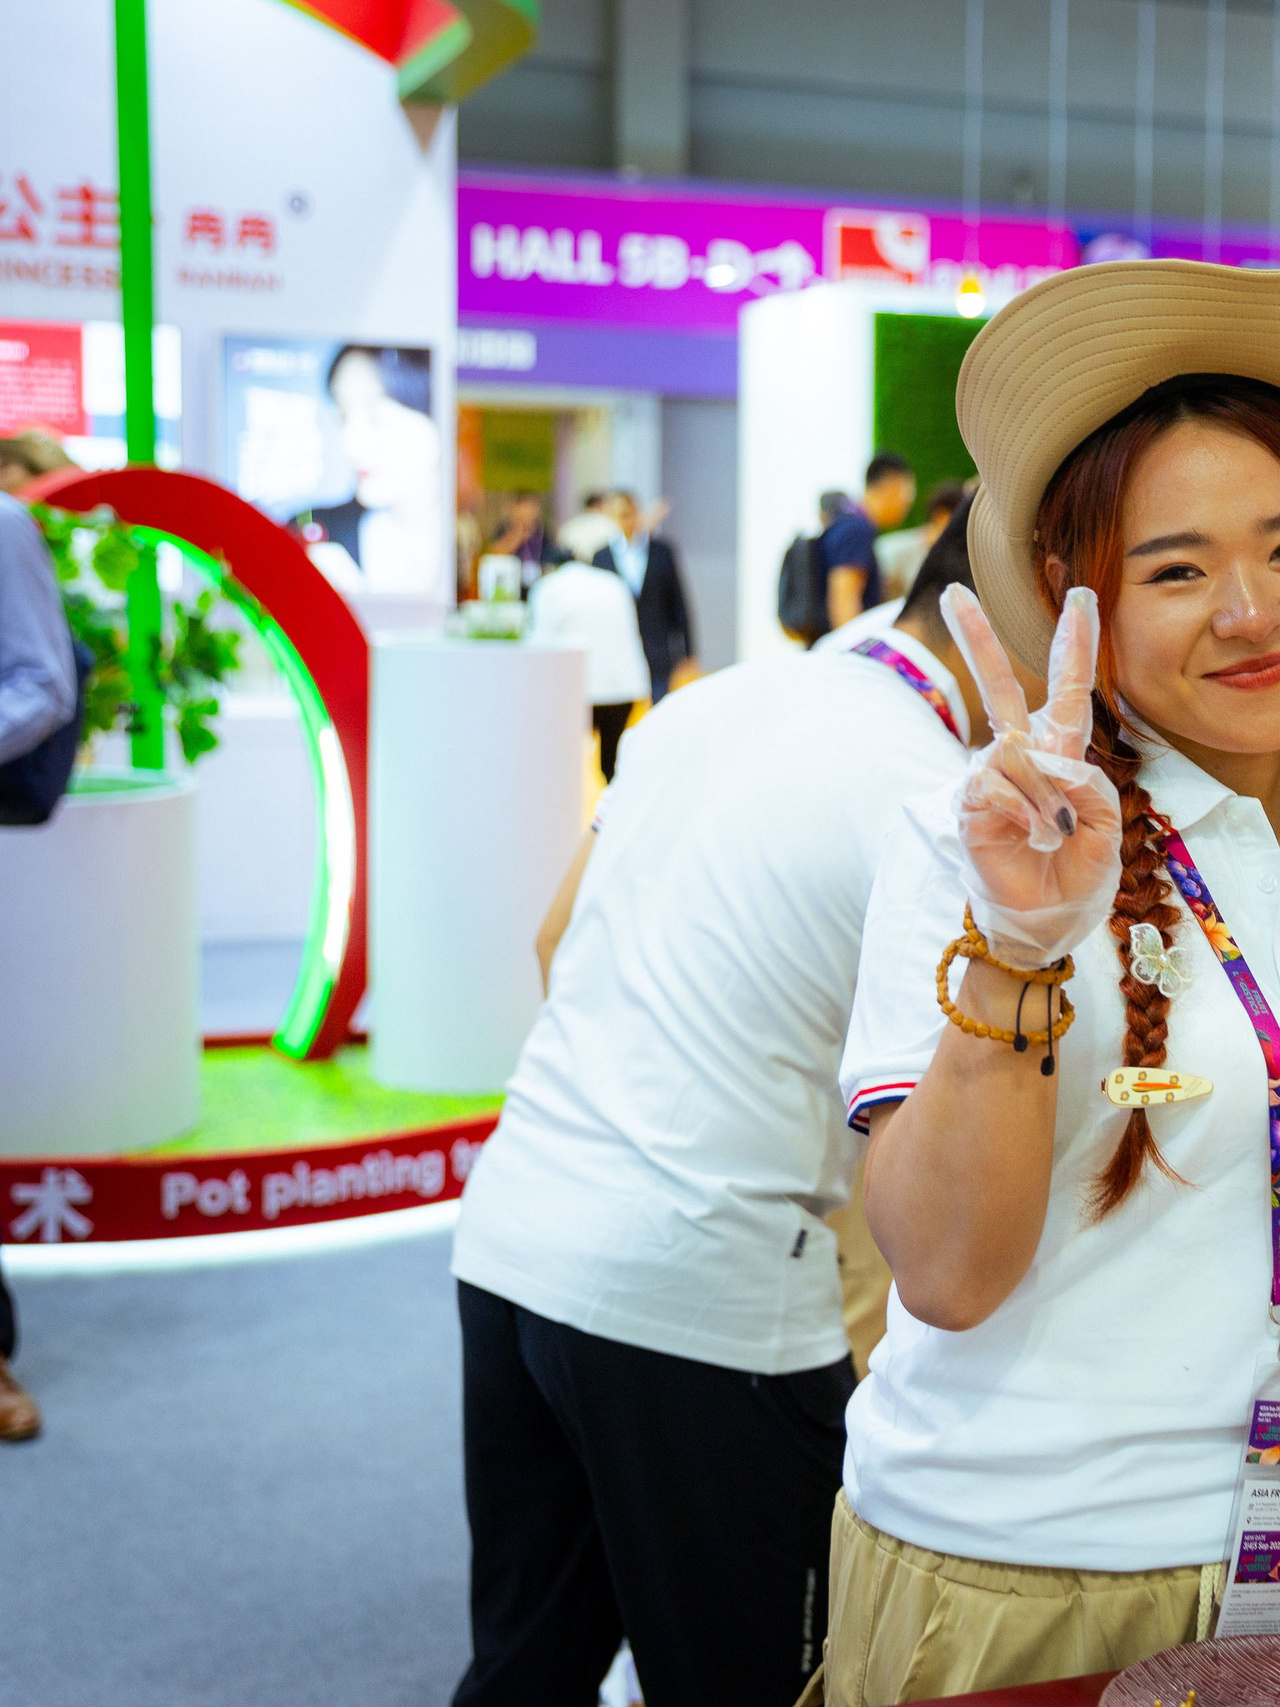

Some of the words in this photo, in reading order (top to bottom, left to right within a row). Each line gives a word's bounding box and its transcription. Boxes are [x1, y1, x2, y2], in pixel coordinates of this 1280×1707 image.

[470, 222, 615, 286] HALL
[159, 1170, 251, 1219] Pot
[262, 1150, 446, 1220] planting
[1251, 1489, 1269, 1498] ASIA
